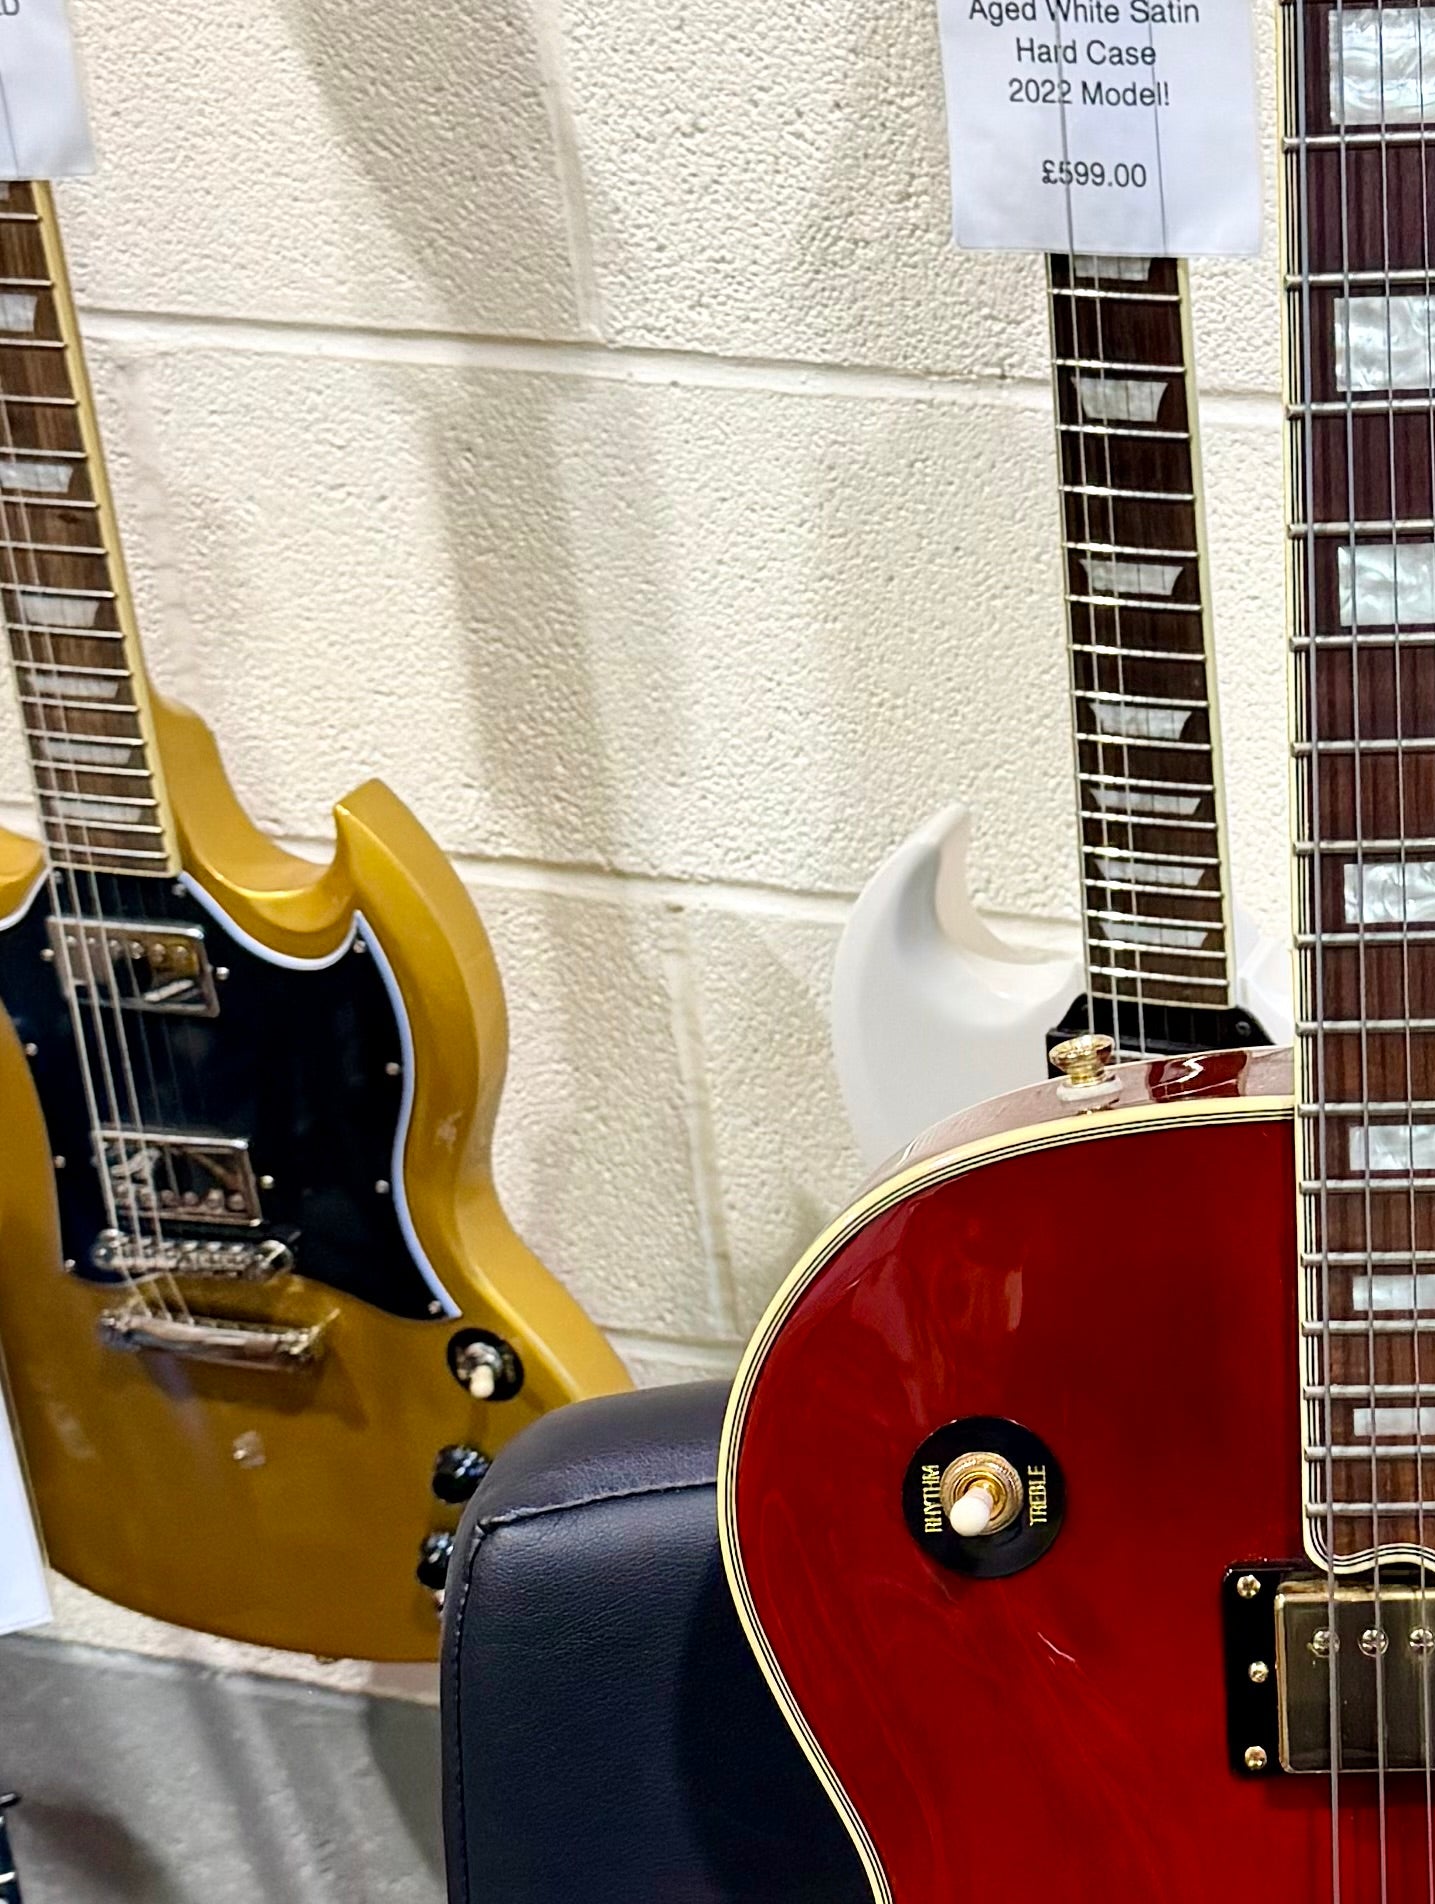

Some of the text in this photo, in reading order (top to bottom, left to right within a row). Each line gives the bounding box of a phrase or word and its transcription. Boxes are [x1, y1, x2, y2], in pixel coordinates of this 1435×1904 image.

[1016, 38, 1156, 66] Hard Case
[1009, 79, 1170, 106] 2022 Model!
[1042, 160, 1146, 187] £599.00
[921, 1465, 943, 1533] RHYTHM
[1027, 1465, 1047, 1526] TREBLE
